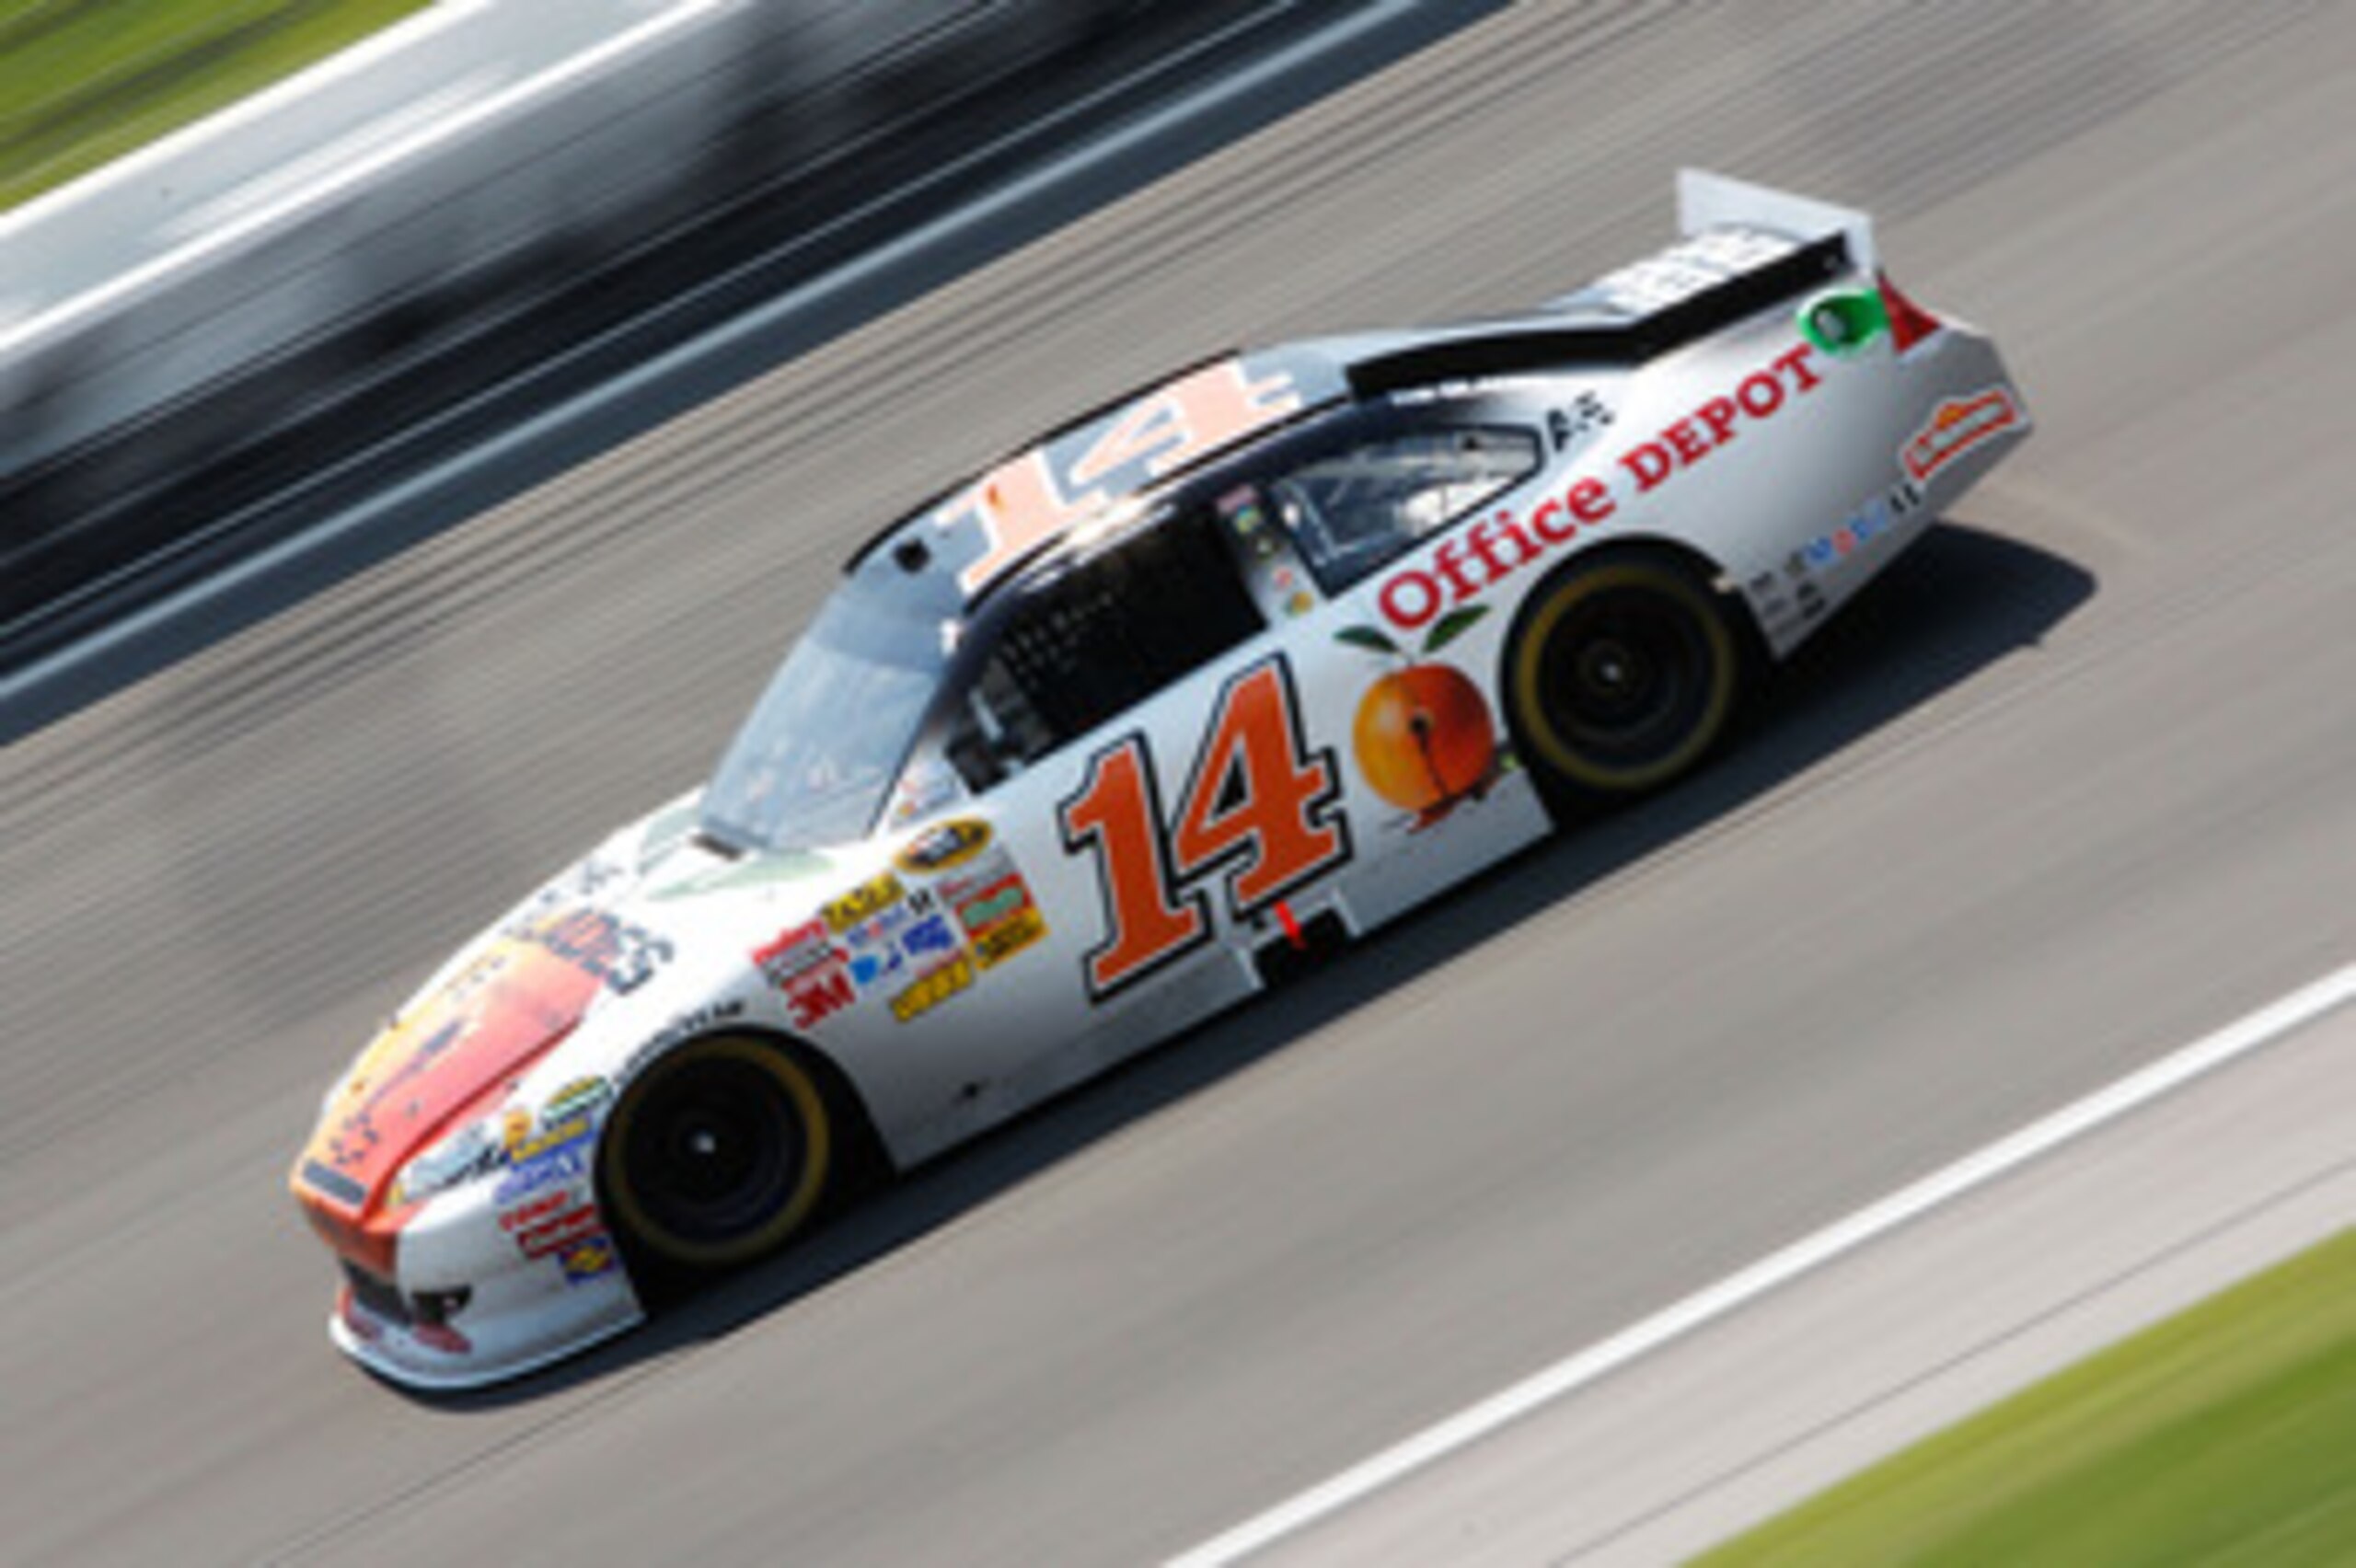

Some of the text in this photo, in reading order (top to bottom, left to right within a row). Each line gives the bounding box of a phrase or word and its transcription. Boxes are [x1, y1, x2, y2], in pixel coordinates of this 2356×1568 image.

[918, 361, 1301, 594] 14
[1379, 476, 1617, 629] Office
[1618, 342, 1822, 492] DEPOT
[1057, 650, 1354, 1005] 14
